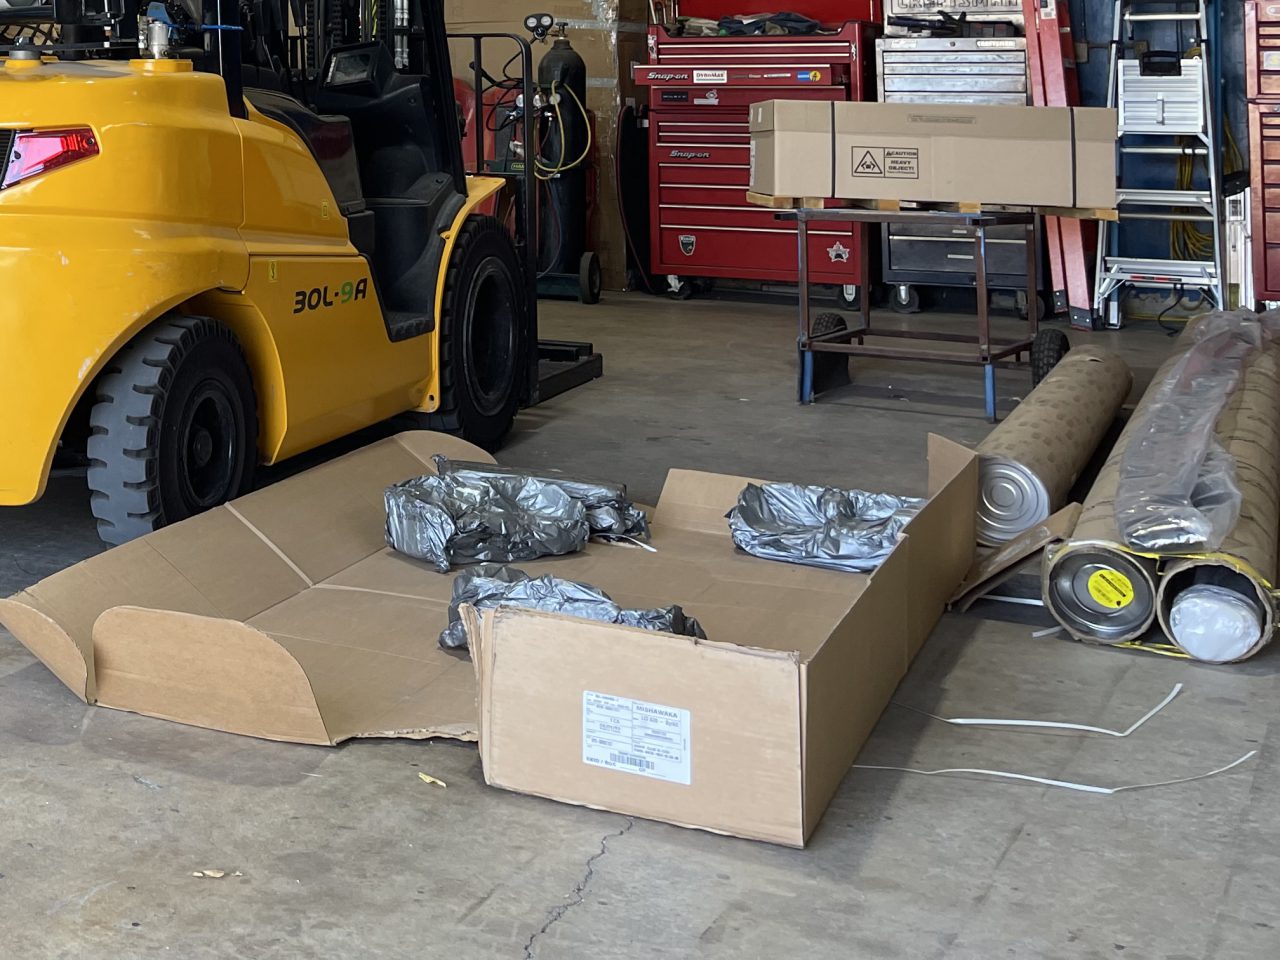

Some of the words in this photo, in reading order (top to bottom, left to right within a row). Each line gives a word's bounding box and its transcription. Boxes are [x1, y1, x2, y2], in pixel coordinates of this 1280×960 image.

[647, 71, 689, 81] Snap-on
[669, 149, 710, 159] Snap-on
[636, 705, 678, 718] MISHAWAKA
